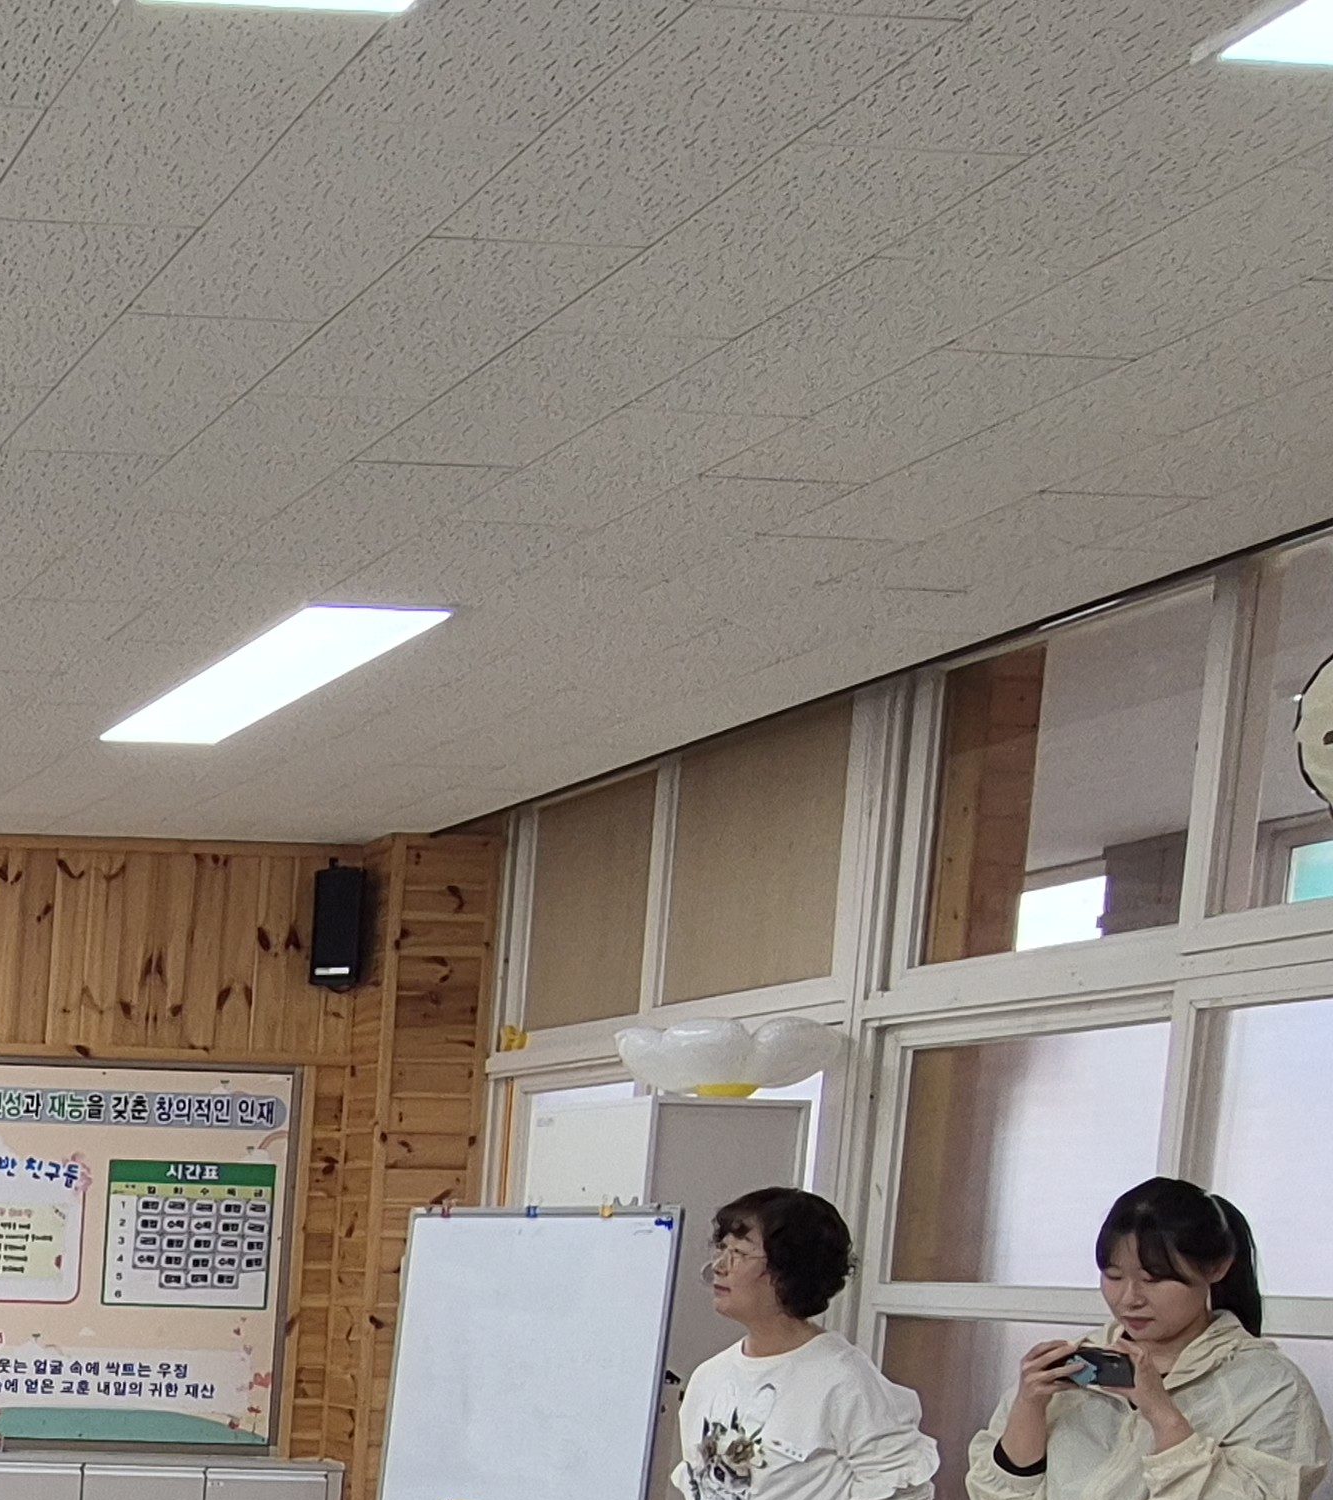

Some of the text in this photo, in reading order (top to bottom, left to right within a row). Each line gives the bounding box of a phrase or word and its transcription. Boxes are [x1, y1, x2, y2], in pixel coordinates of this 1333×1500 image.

[49, 1093, 104, 1119] 재능을
[112, 1095, 148, 1121] 갖춘
[156, 1096, 230, 1123] 창의적인
[238, 1099, 275, 1126] 인재
[25, 1157, 78, 1188] 친구들
[166, 1163, 219, 1180] 시간표
[34, 1359, 63, 1375] 얼굴
[70, 1360, 100, 1376] 속에
[106, 1361, 152, 1378] 싹트는
[157, 1363, 188, 1379] 우정
[25, 1379, 55, 1394] 얻은
[60, 1380, 90, 1395] 교훈
[97, 1381, 143, 1397] 내일의
[148, 1382, 178, 1398] 귀한
[184, 1383, 215, 1399] 재산
